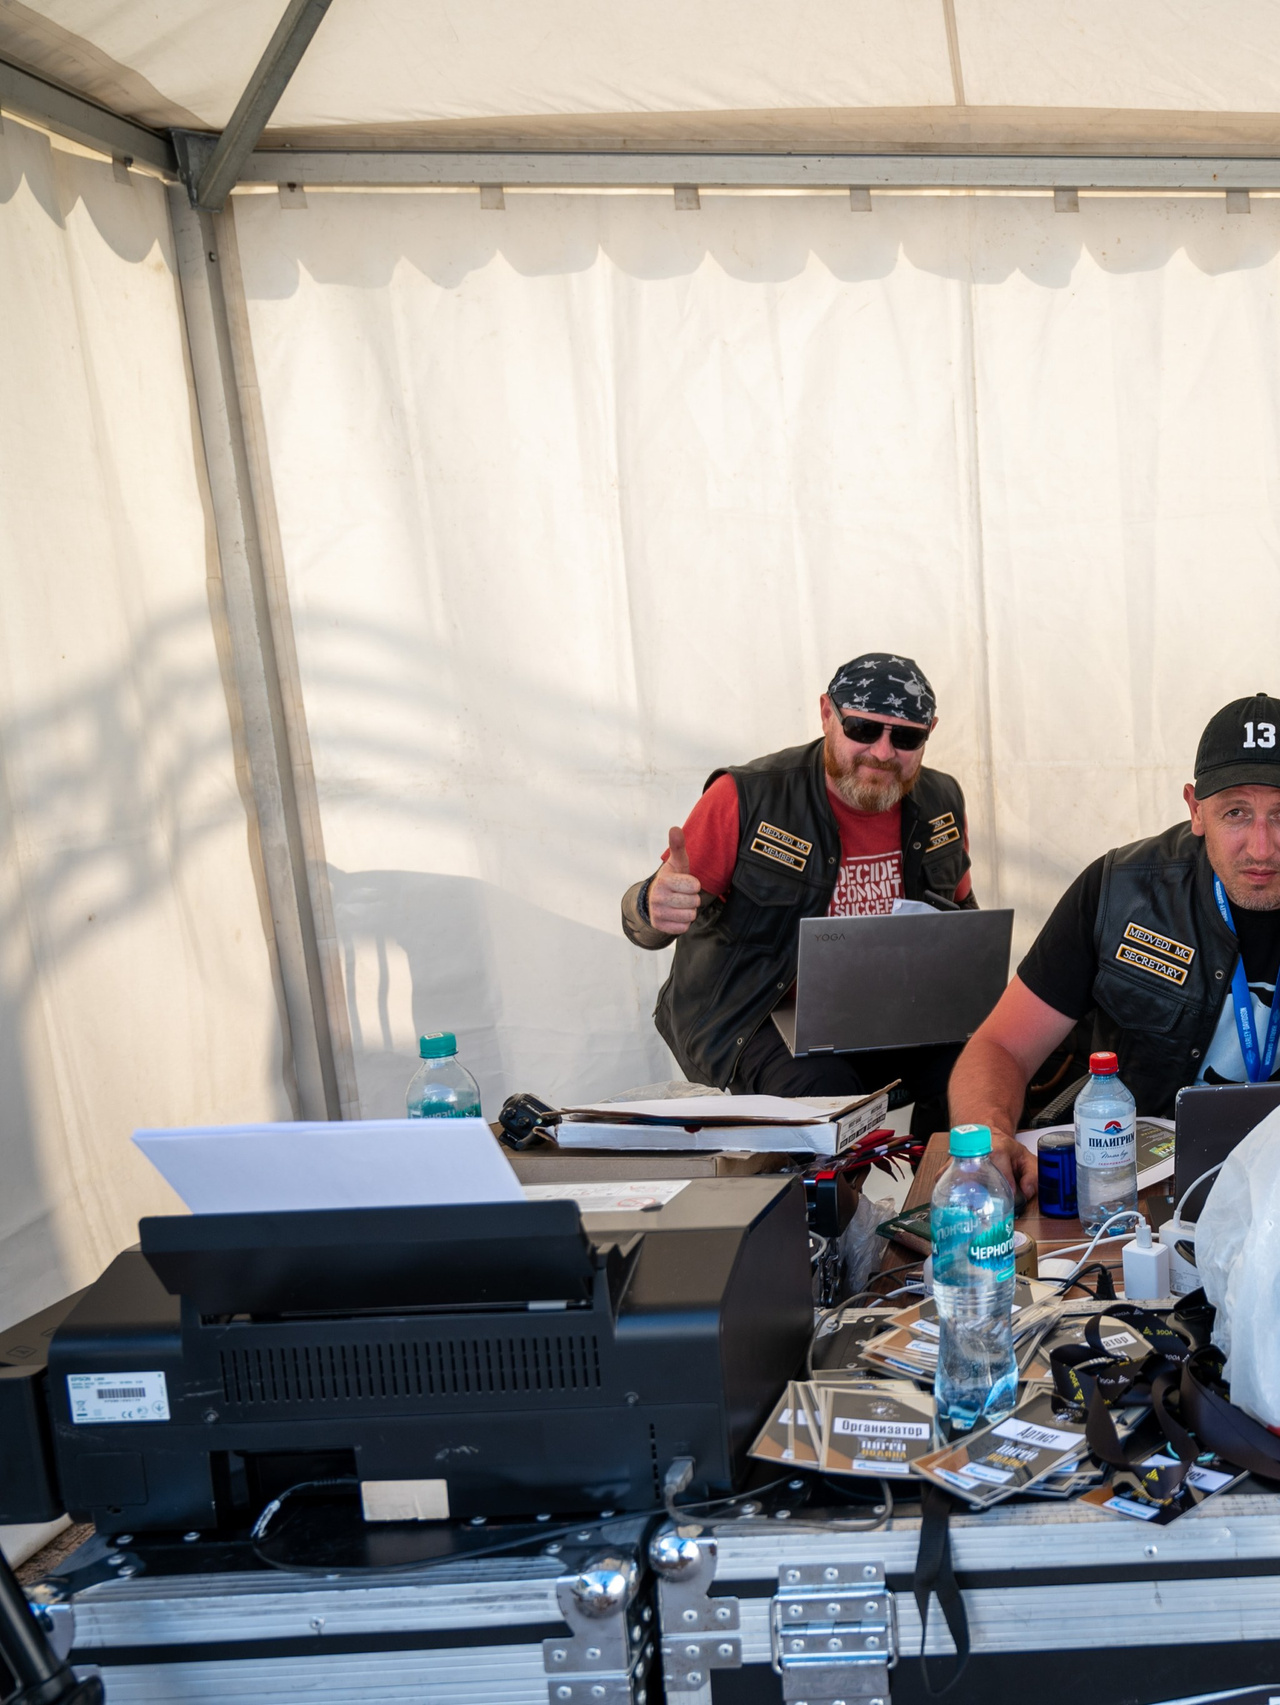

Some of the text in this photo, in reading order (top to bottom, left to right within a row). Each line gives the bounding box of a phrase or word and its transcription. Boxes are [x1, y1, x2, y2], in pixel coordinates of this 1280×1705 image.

[1243, 722, 1276, 748] 13
[761, 825, 809, 852] MEDVEDI MC
[762, 845, 795, 865] MEMBER
[838, 859, 900, 886] DECIDE
[833, 878, 902, 905] COMMIT
[834, 899, 894, 917] SUCCEE
[815, 933, 846, 942] YOGA
[1128, 927, 1190, 959] MEDVEDI MC
[1123, 950, 1181, 979] SECRETARY
[842, 1419, 923, 1437] Организатор
[1017, 1426, 1061, 1444] Артист
